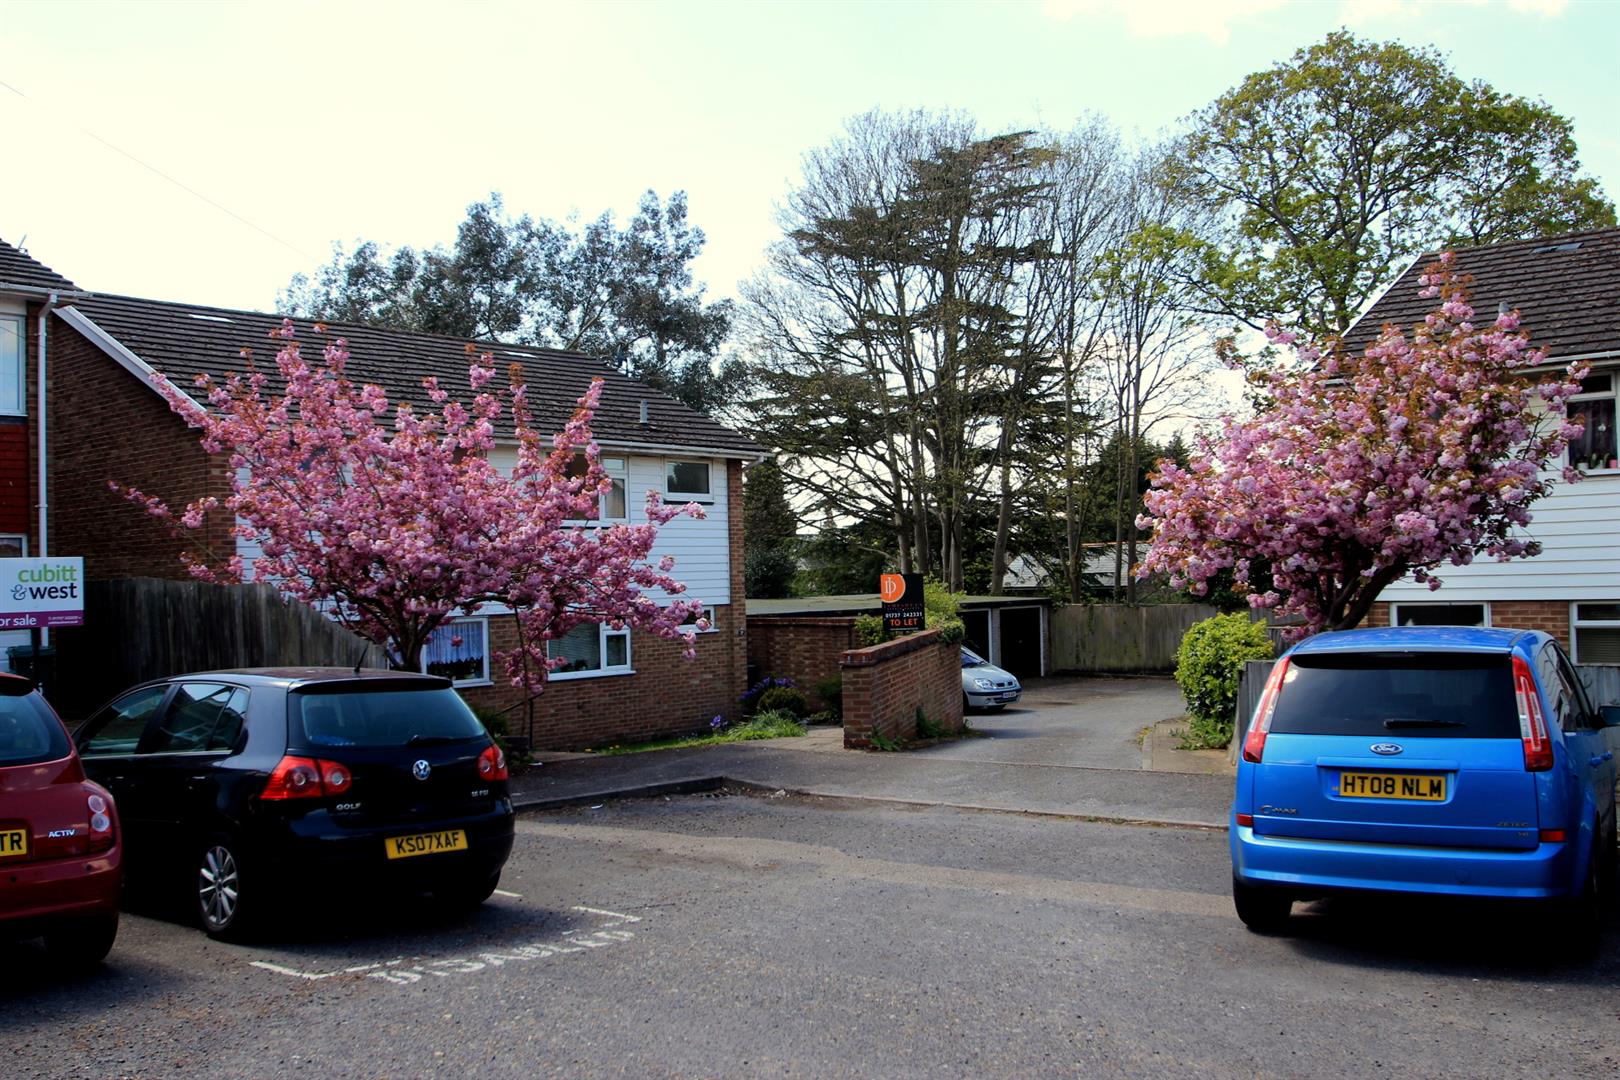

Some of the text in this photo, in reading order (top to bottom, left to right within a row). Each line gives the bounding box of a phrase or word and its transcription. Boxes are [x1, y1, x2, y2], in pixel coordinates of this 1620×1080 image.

[18, 563, 77, 582] cubitt
[29, 583, 78, 600] west
[13, 614, 37, 626] sale
[903, 618, 919, 626] LET
[1343, 776, 1442, 798] HT08 NLM
[336, 802, 361, 810] GOLF
[0, 832, 22, 851] TR
[395, 832, 460, 855] KS07XAF
